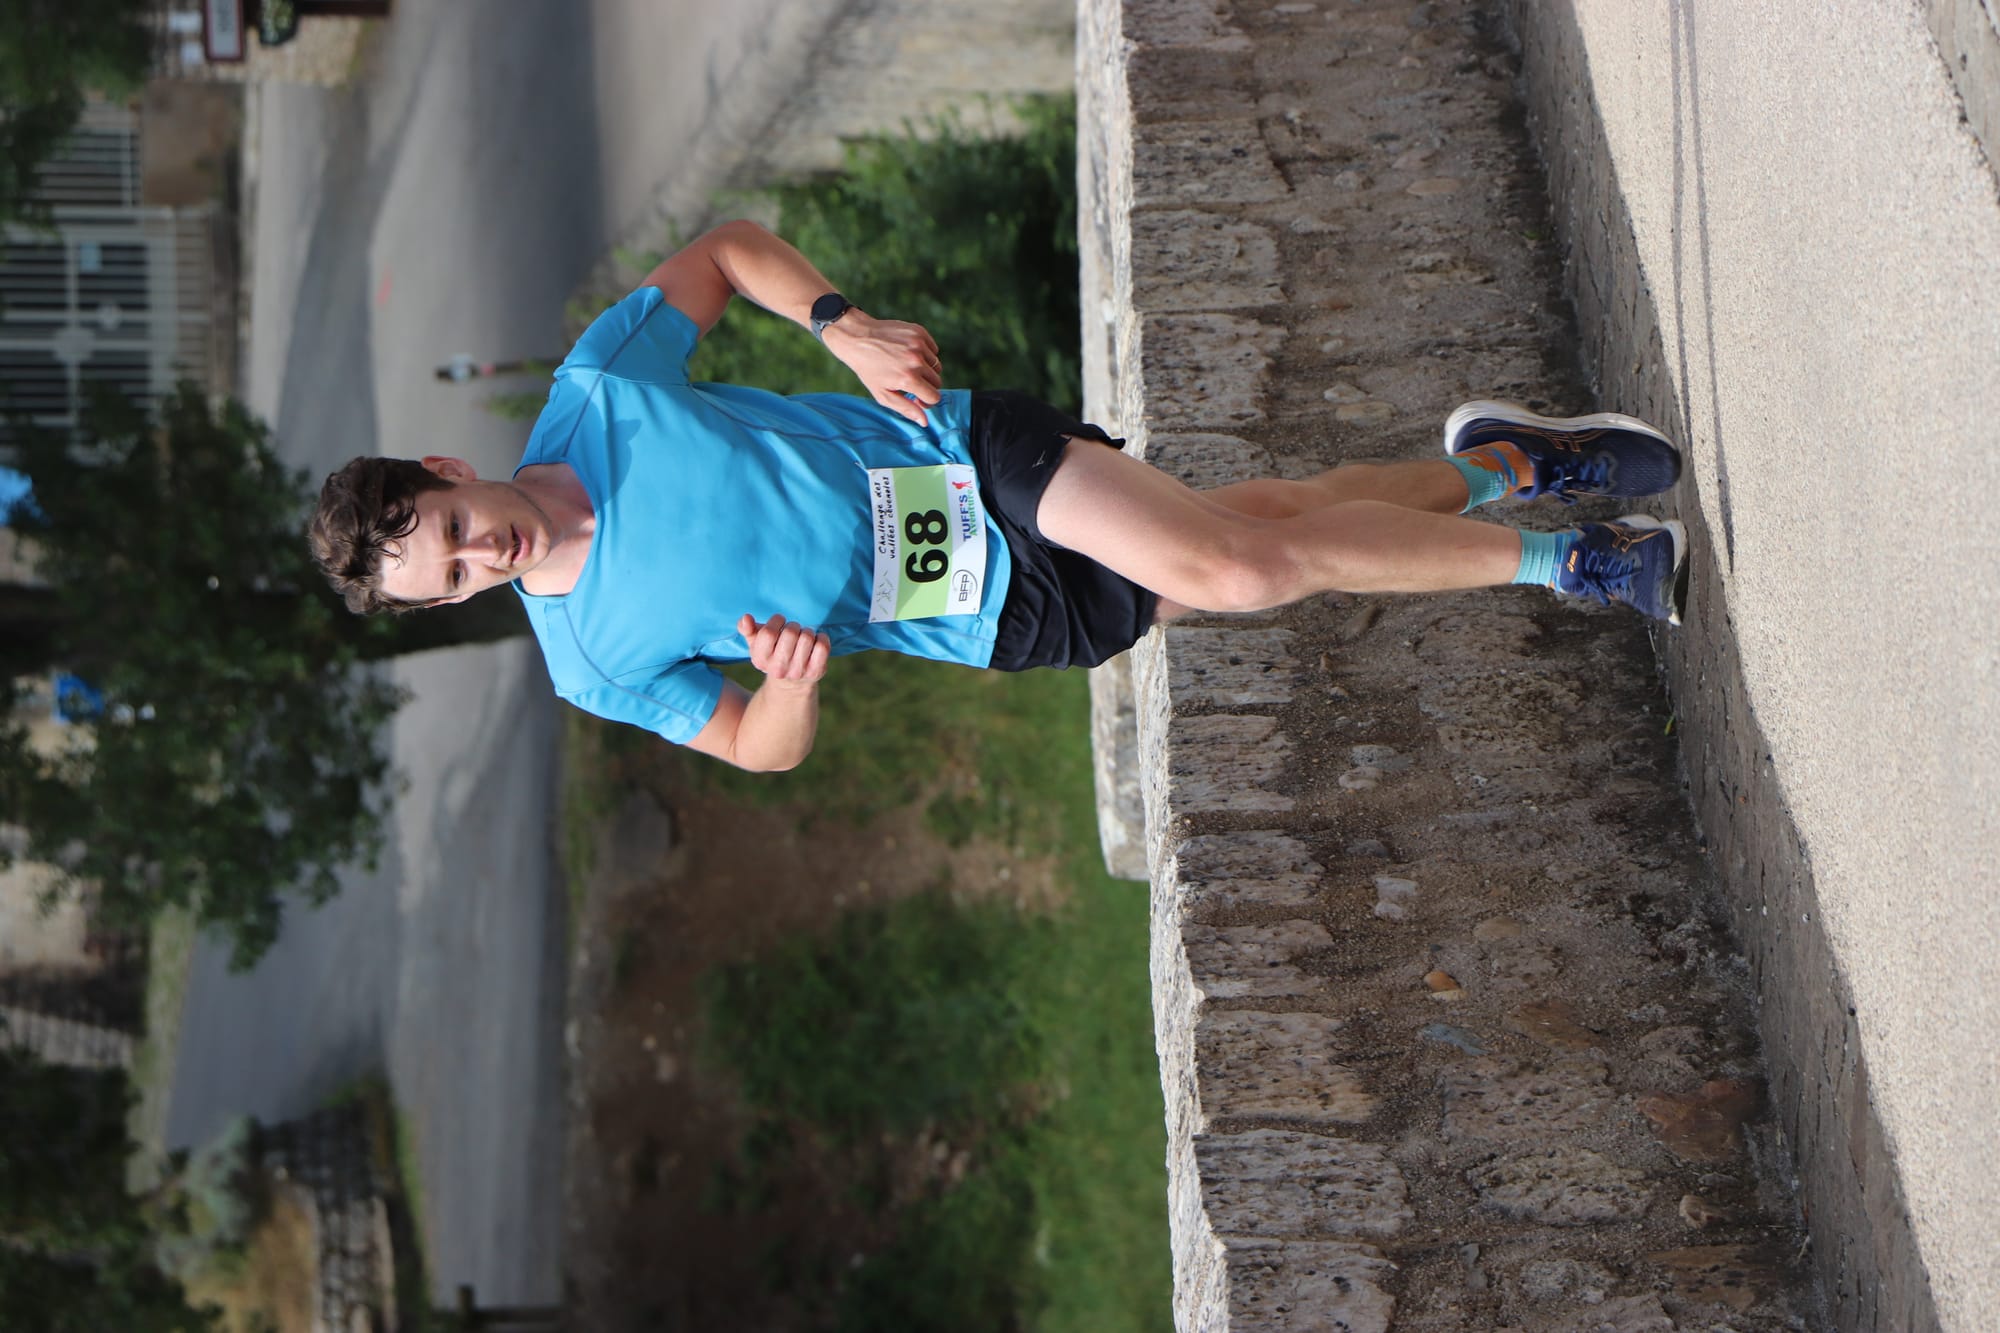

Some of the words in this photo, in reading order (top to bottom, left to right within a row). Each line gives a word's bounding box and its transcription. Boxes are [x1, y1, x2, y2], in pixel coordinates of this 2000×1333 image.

[878, 504, 887, 553] Challenge
[959, 494, 971, 541] TUFF'S
[967, 490, 977, 536] Aventure
[887, 525, 895, 559] vallées
[905, 510, 948, 582] 68
[959, 574, 969, 602] BFP
